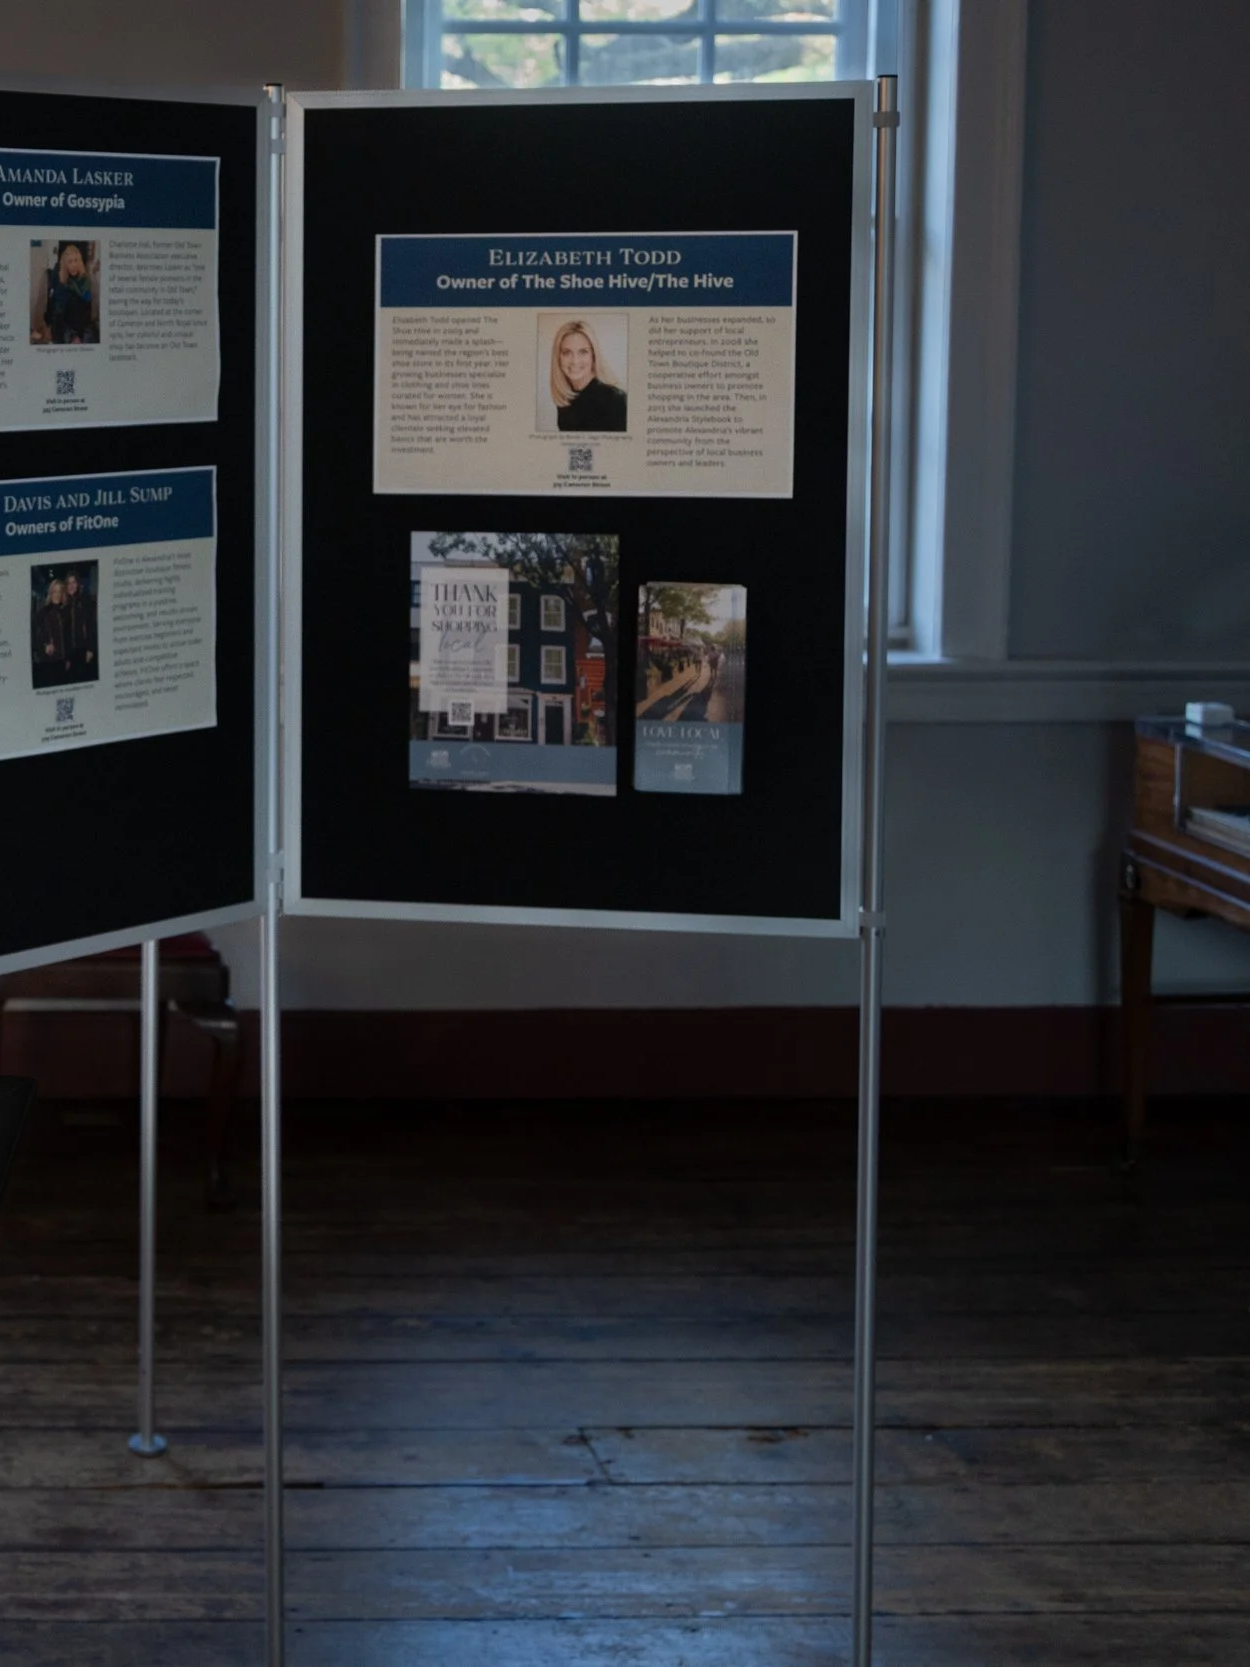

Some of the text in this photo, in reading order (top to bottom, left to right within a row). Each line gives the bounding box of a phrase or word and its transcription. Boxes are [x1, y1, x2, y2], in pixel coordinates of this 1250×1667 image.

[73, 167, 134, 186] LASKER
[2, 191, 125, 213] Owner of Gossypia
[489, 248, 682, 266] ELIZABETH TODD
[436, 272, 734, 292] Owner of The Shoe Hive/The Hive
[4, 495, 52, 513] DAVIS
[94, 489, 126, 506] JILL
[130, 486, 173, 503] SUMP
[5, 514, 119, 537] Owners of FitOne
[431, 583, 498, 603] THANK
[434, 603, 498, 618] YOU FOR
[431, 620, 498, 633] SHOPPING
